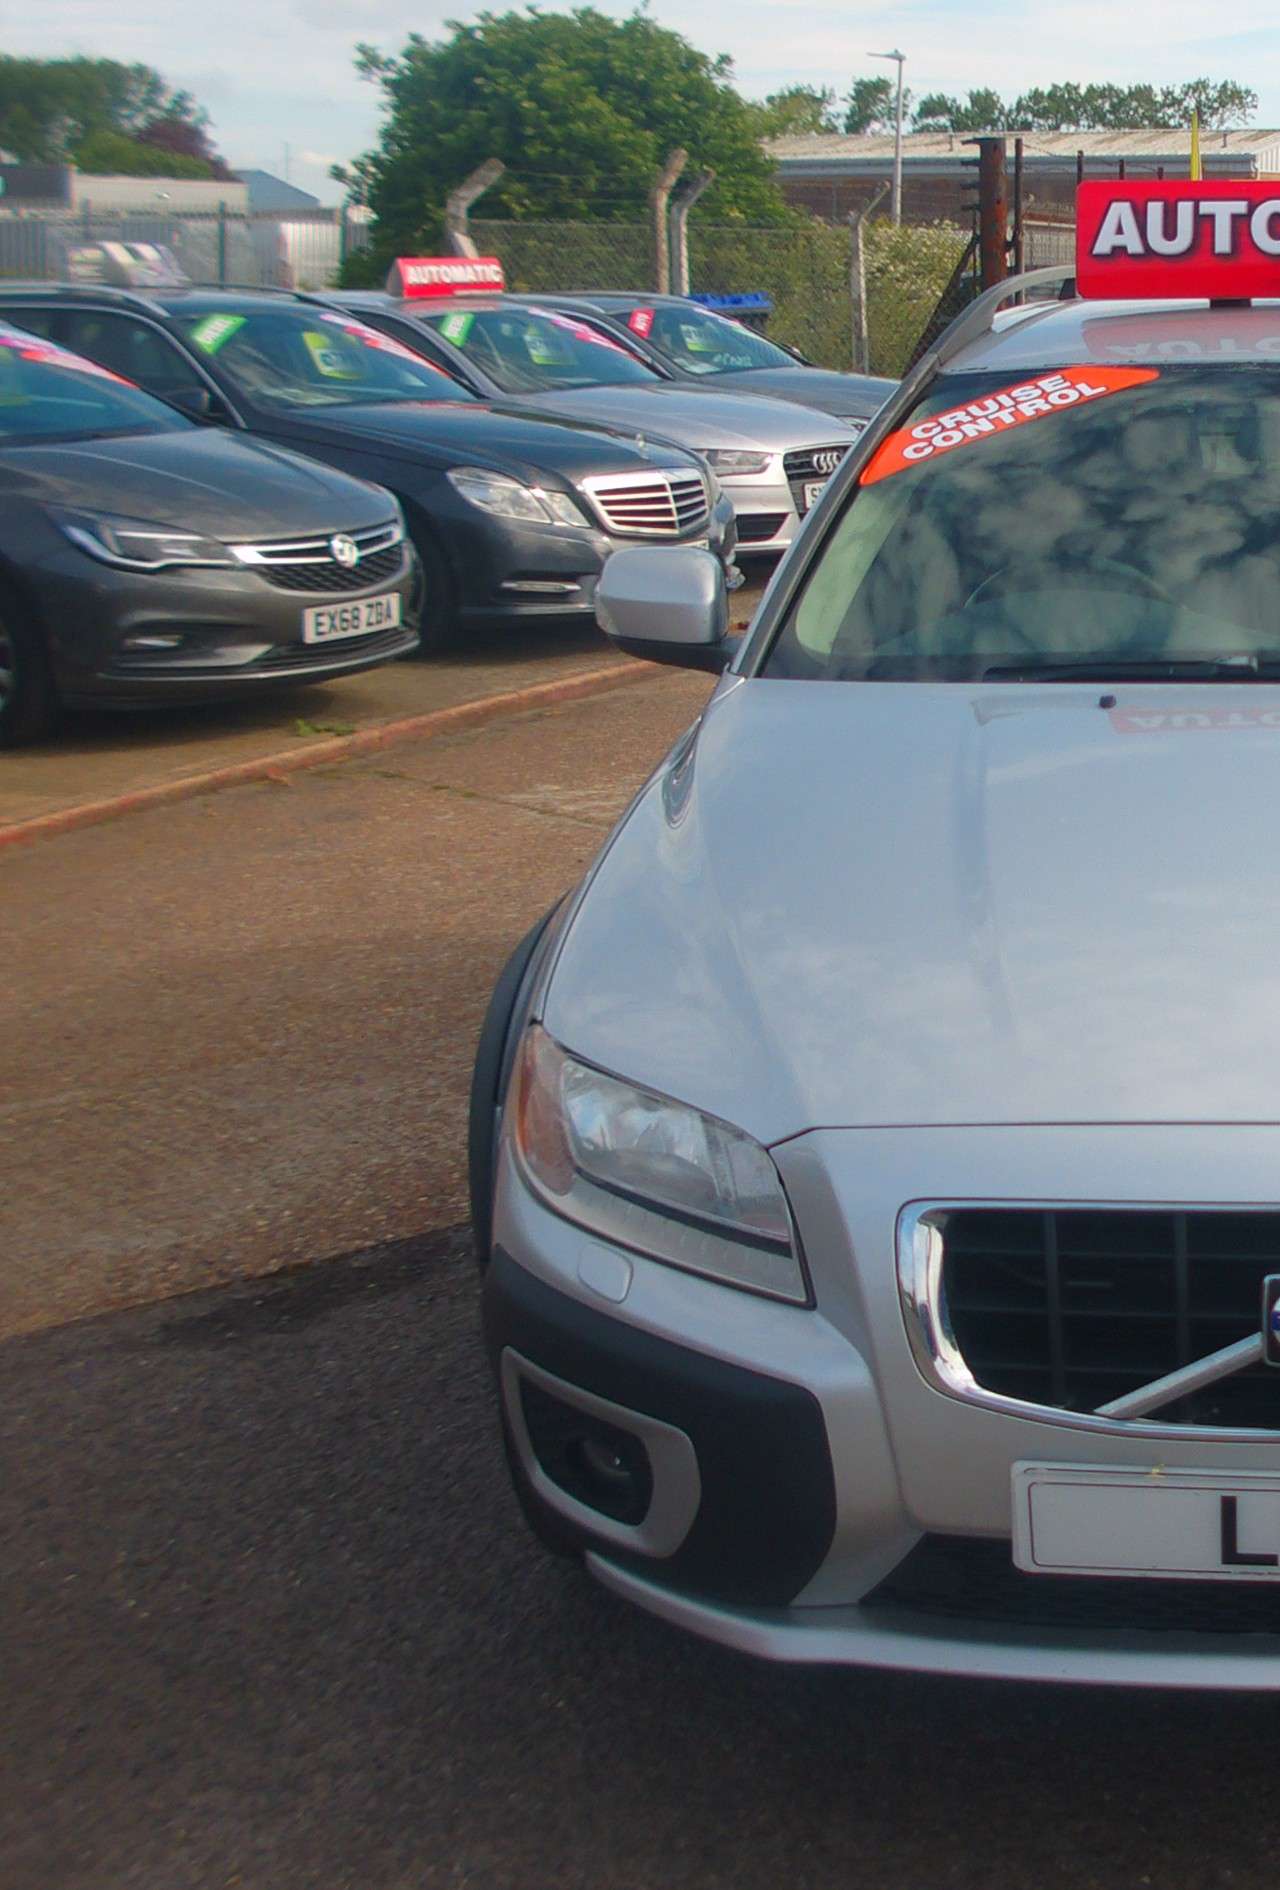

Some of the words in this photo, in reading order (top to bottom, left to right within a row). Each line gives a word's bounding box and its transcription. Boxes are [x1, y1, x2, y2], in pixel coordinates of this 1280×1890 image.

[406, 264, 504, 285] AUTOMATIC
[902, 382, 1107, 460] CONTROL
[910, 374, 1073, 439] CRUISE
[314, 606, 361, 637] EX68
